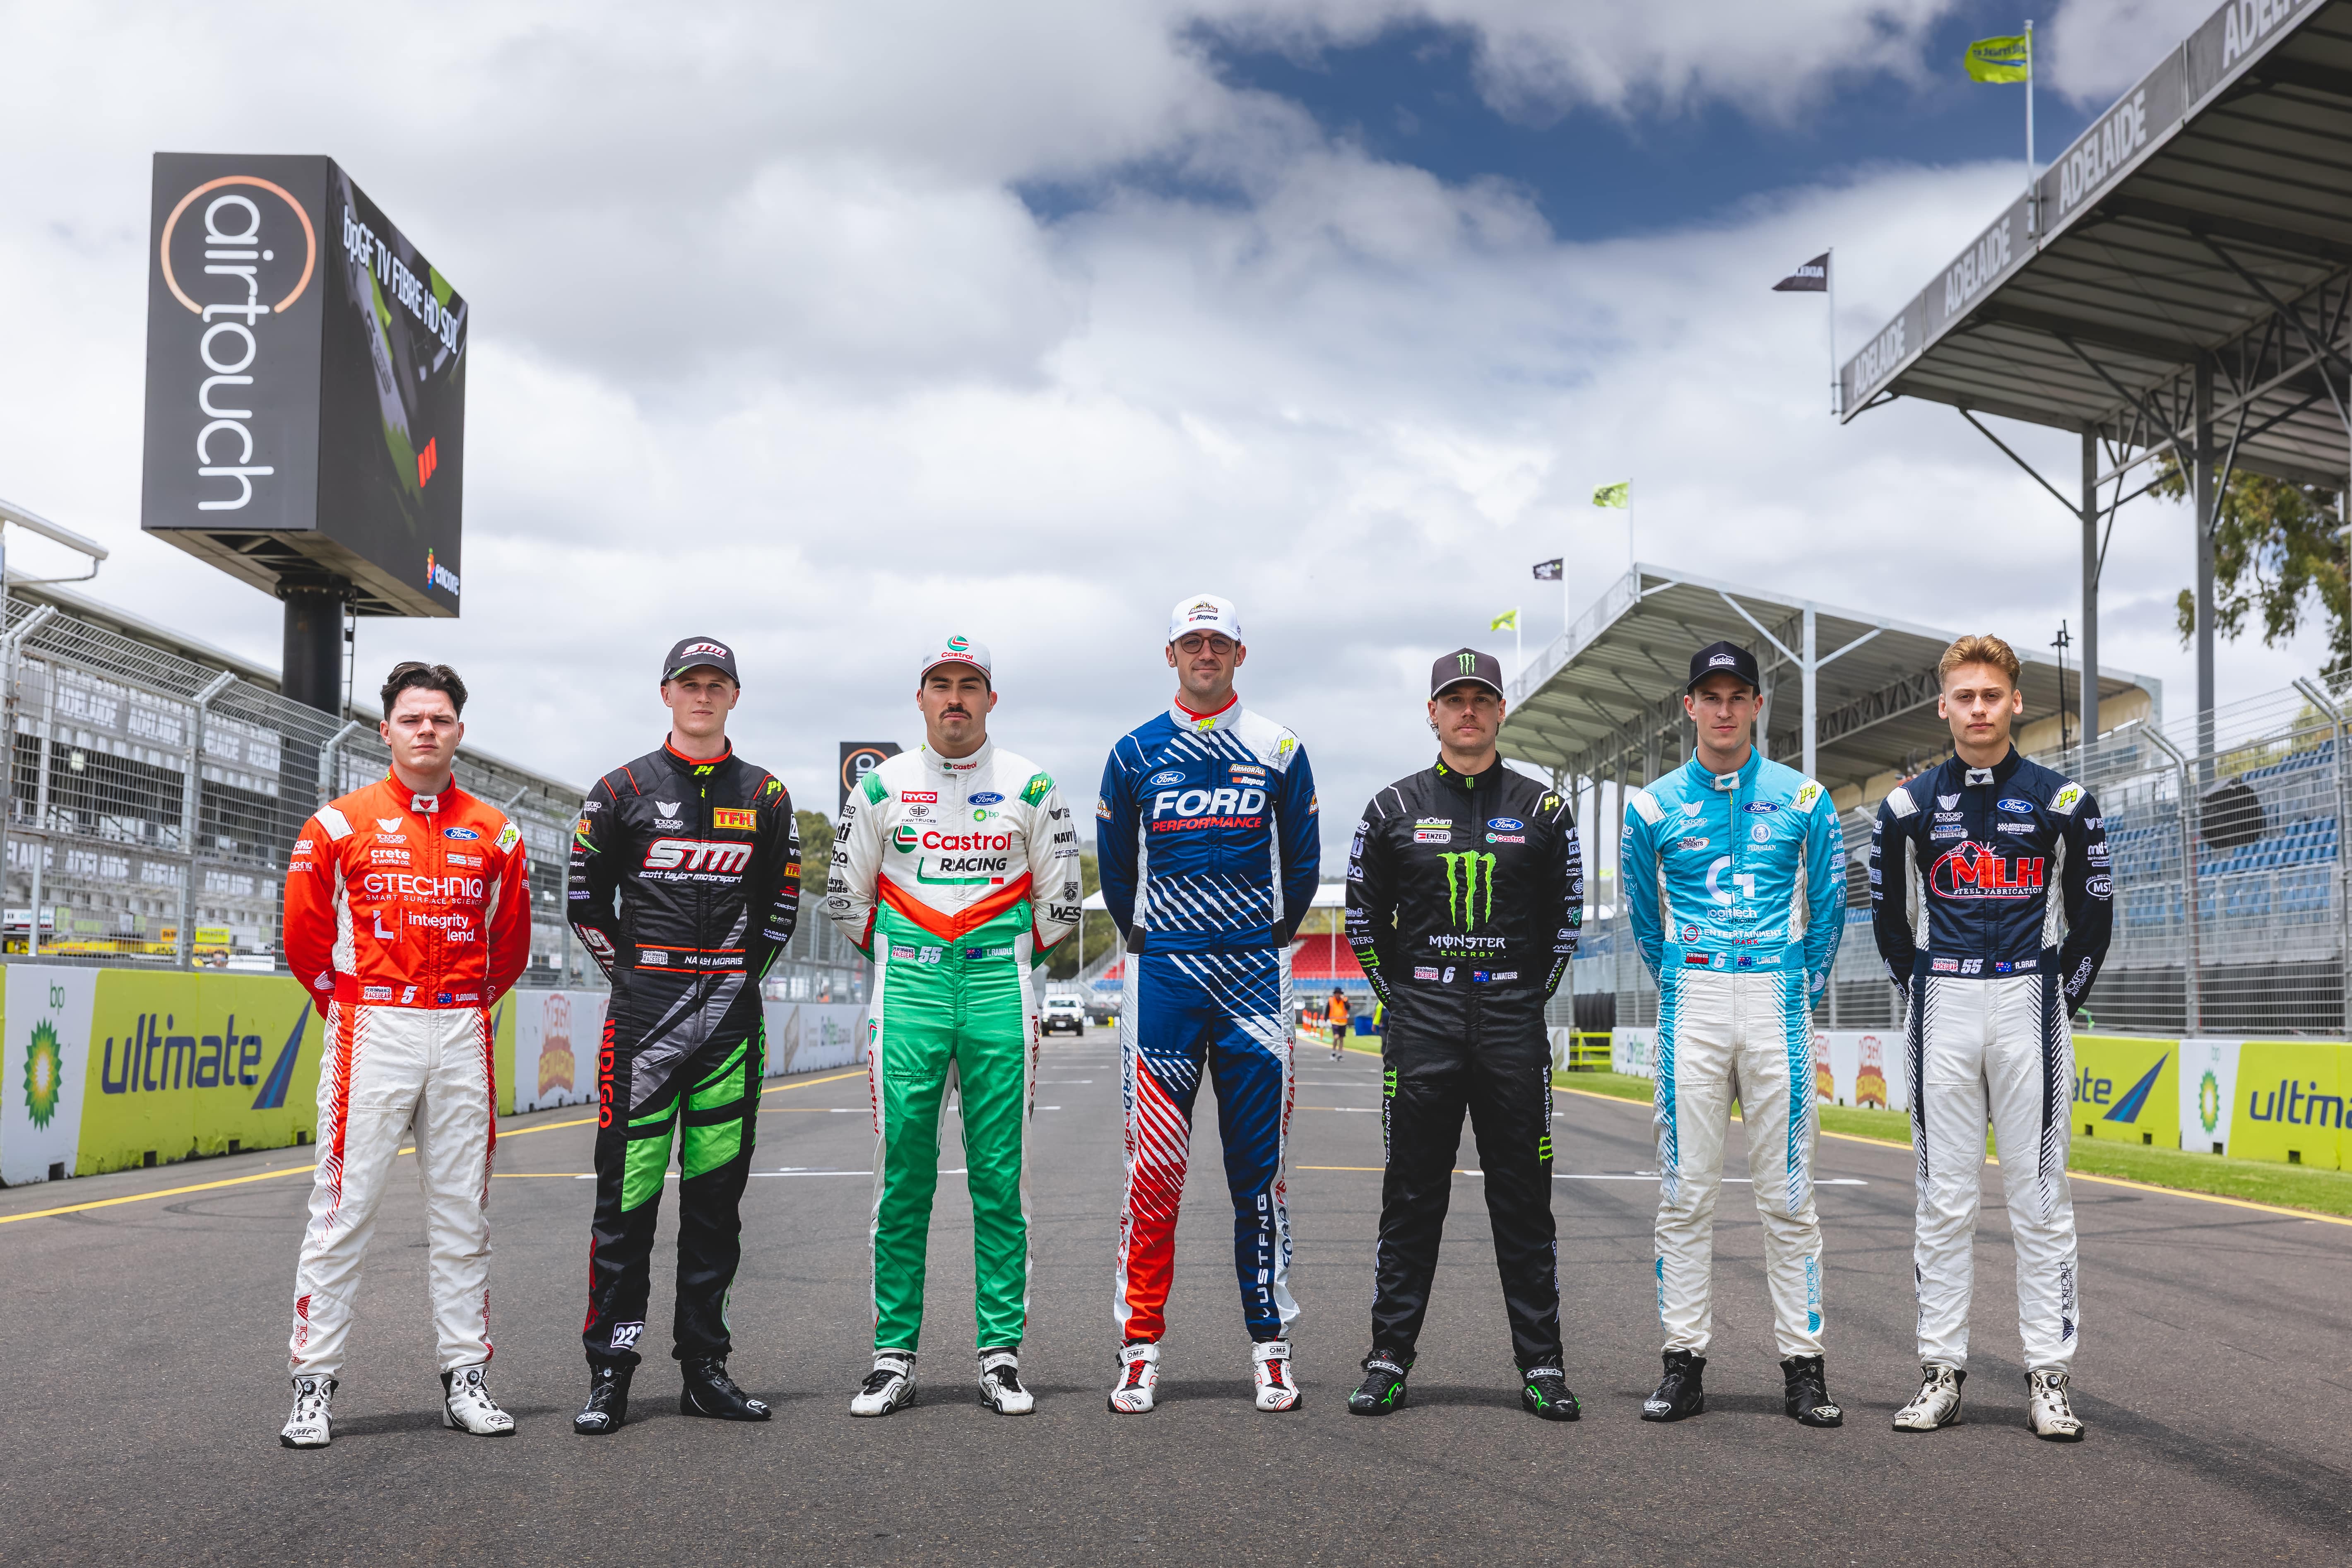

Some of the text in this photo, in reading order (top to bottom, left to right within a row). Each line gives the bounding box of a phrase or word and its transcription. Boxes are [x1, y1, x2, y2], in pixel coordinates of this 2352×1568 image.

[2058, 89, 2146, 214] ADELAIDE
[1943, 216, 2011, 318] ADELAIDE
[343, 205, 457, 354] bpGF TV FIBRE HD SDI
[196, 195, 275, 511] airtouch
[1852, 316, 1904, 402] ADELAIDE
[435, 562, 459, 596] encore
[941, 651, 973, 661] Castrol
[1197, 718, 1217, 731] P1
[1279, 737, 1294, 754] P1
[693, 765, 715, 775] P1
[953, 761, 977, 770] Castrol
[1436, 763, 1448, 776] P1
[1157, 773, 1179, 783] Ford
[1240, 776, 1266, 786] Repco
[766, 780, 782, 795] P1
[1030, 778, 1047, 795] P1
[903, 793, 936, 801] RYCO
[975, 794, 997, 803] Ford
[1800, 785, 1816, 804] P1
[2058, 788, 2077, 808] P1
[1153, 788, 1266, 819] FORD
[1544, 795, 1560, 811] P1
[1750, 802, 1772, 812] Ford
[2005, 800, 2027, 812] Ford
[717, 812, 750, 826] TFH
[989, 810, 999, 819] bp
[1679, 817, 1708, 826] TICKFORD
[1152, 816, 1263, 832] PERFORMANCE
[1495, 819, 1516, 829] Ford
[450, 829, 472, 839] Ford
[503, 829, 516, 844] P1
[922, 831, 1013, 851] Castrol
[1054, 831, 1073, 844] NAVY
[1497, 834, 1524, 843] Castrol
[370, 849, 410, 860] crete
[643, 837, 754, 872] STM
[940, 857, 1007, 871] RACING
[664, 871, 693, 880] taylor
[1950, 856, 2045, 889] MLH
[364, 873, 484, 898] GTECHNIQ
[1984, 886, 2044, 895] FABRICATION
[408, 911, 469, 929] integrity
[1050, 903, 1082, 922] WES
[447, 928, 476, 943] lend.
[763, 932, 787, 942] MARKETS
[764, 928, 787, 938] CARRARA
[1704, 928, 1782, 939] ENTERTAINMENT
[986, 947, 1014, 957] T.RANDLE
[1821, 926, 1838, 968] TICKFORD
[712, 957, 744, 966] MORRIS
[917, 946, 943, 964] 55
[1714, 952, 1727, 968] 6
[1756, 956, 1780, 965] L.DALTON
[1960, 959, 1984, 974] 55
[2015, 959, 2037, 970] R.GRAY
[1442, 967, 1456, 983] 6
[1492, 971, 1518, 980] C.WATERS
[2065, 956, 2091, 994] TICKFORD
[2072, 963, 2094, 997] AUTOSPORT
[50, 978, 65, 1014] bp
[400, 986, 418, 1004] 5
[455, 992, 479, 1002] R.GOODALL
[101, 1013, 262, 1095] ultimate
[2211, 1044, 2221, 1062] bp
[598, 1019, 615, 1129] INDIGO
[1122, 1044, 1132, 1110] FORD
[868, 1049, 879, 1135] Castrol
[2249, 1079, 2352, 1130] ultim
[1281, 1206, 1293, 1269] FORD
[2060, 1262, 2069, 1313] TICKFORD
[1127, 1349, 1144, 1359] OMP
[1122, 1393, 1144, 1406] OMP
[1267, 1392, 1286, 1405] OMP
[576, 1413, 606, 1423] OMP
[285, 1427, 318, 1439] OMP
